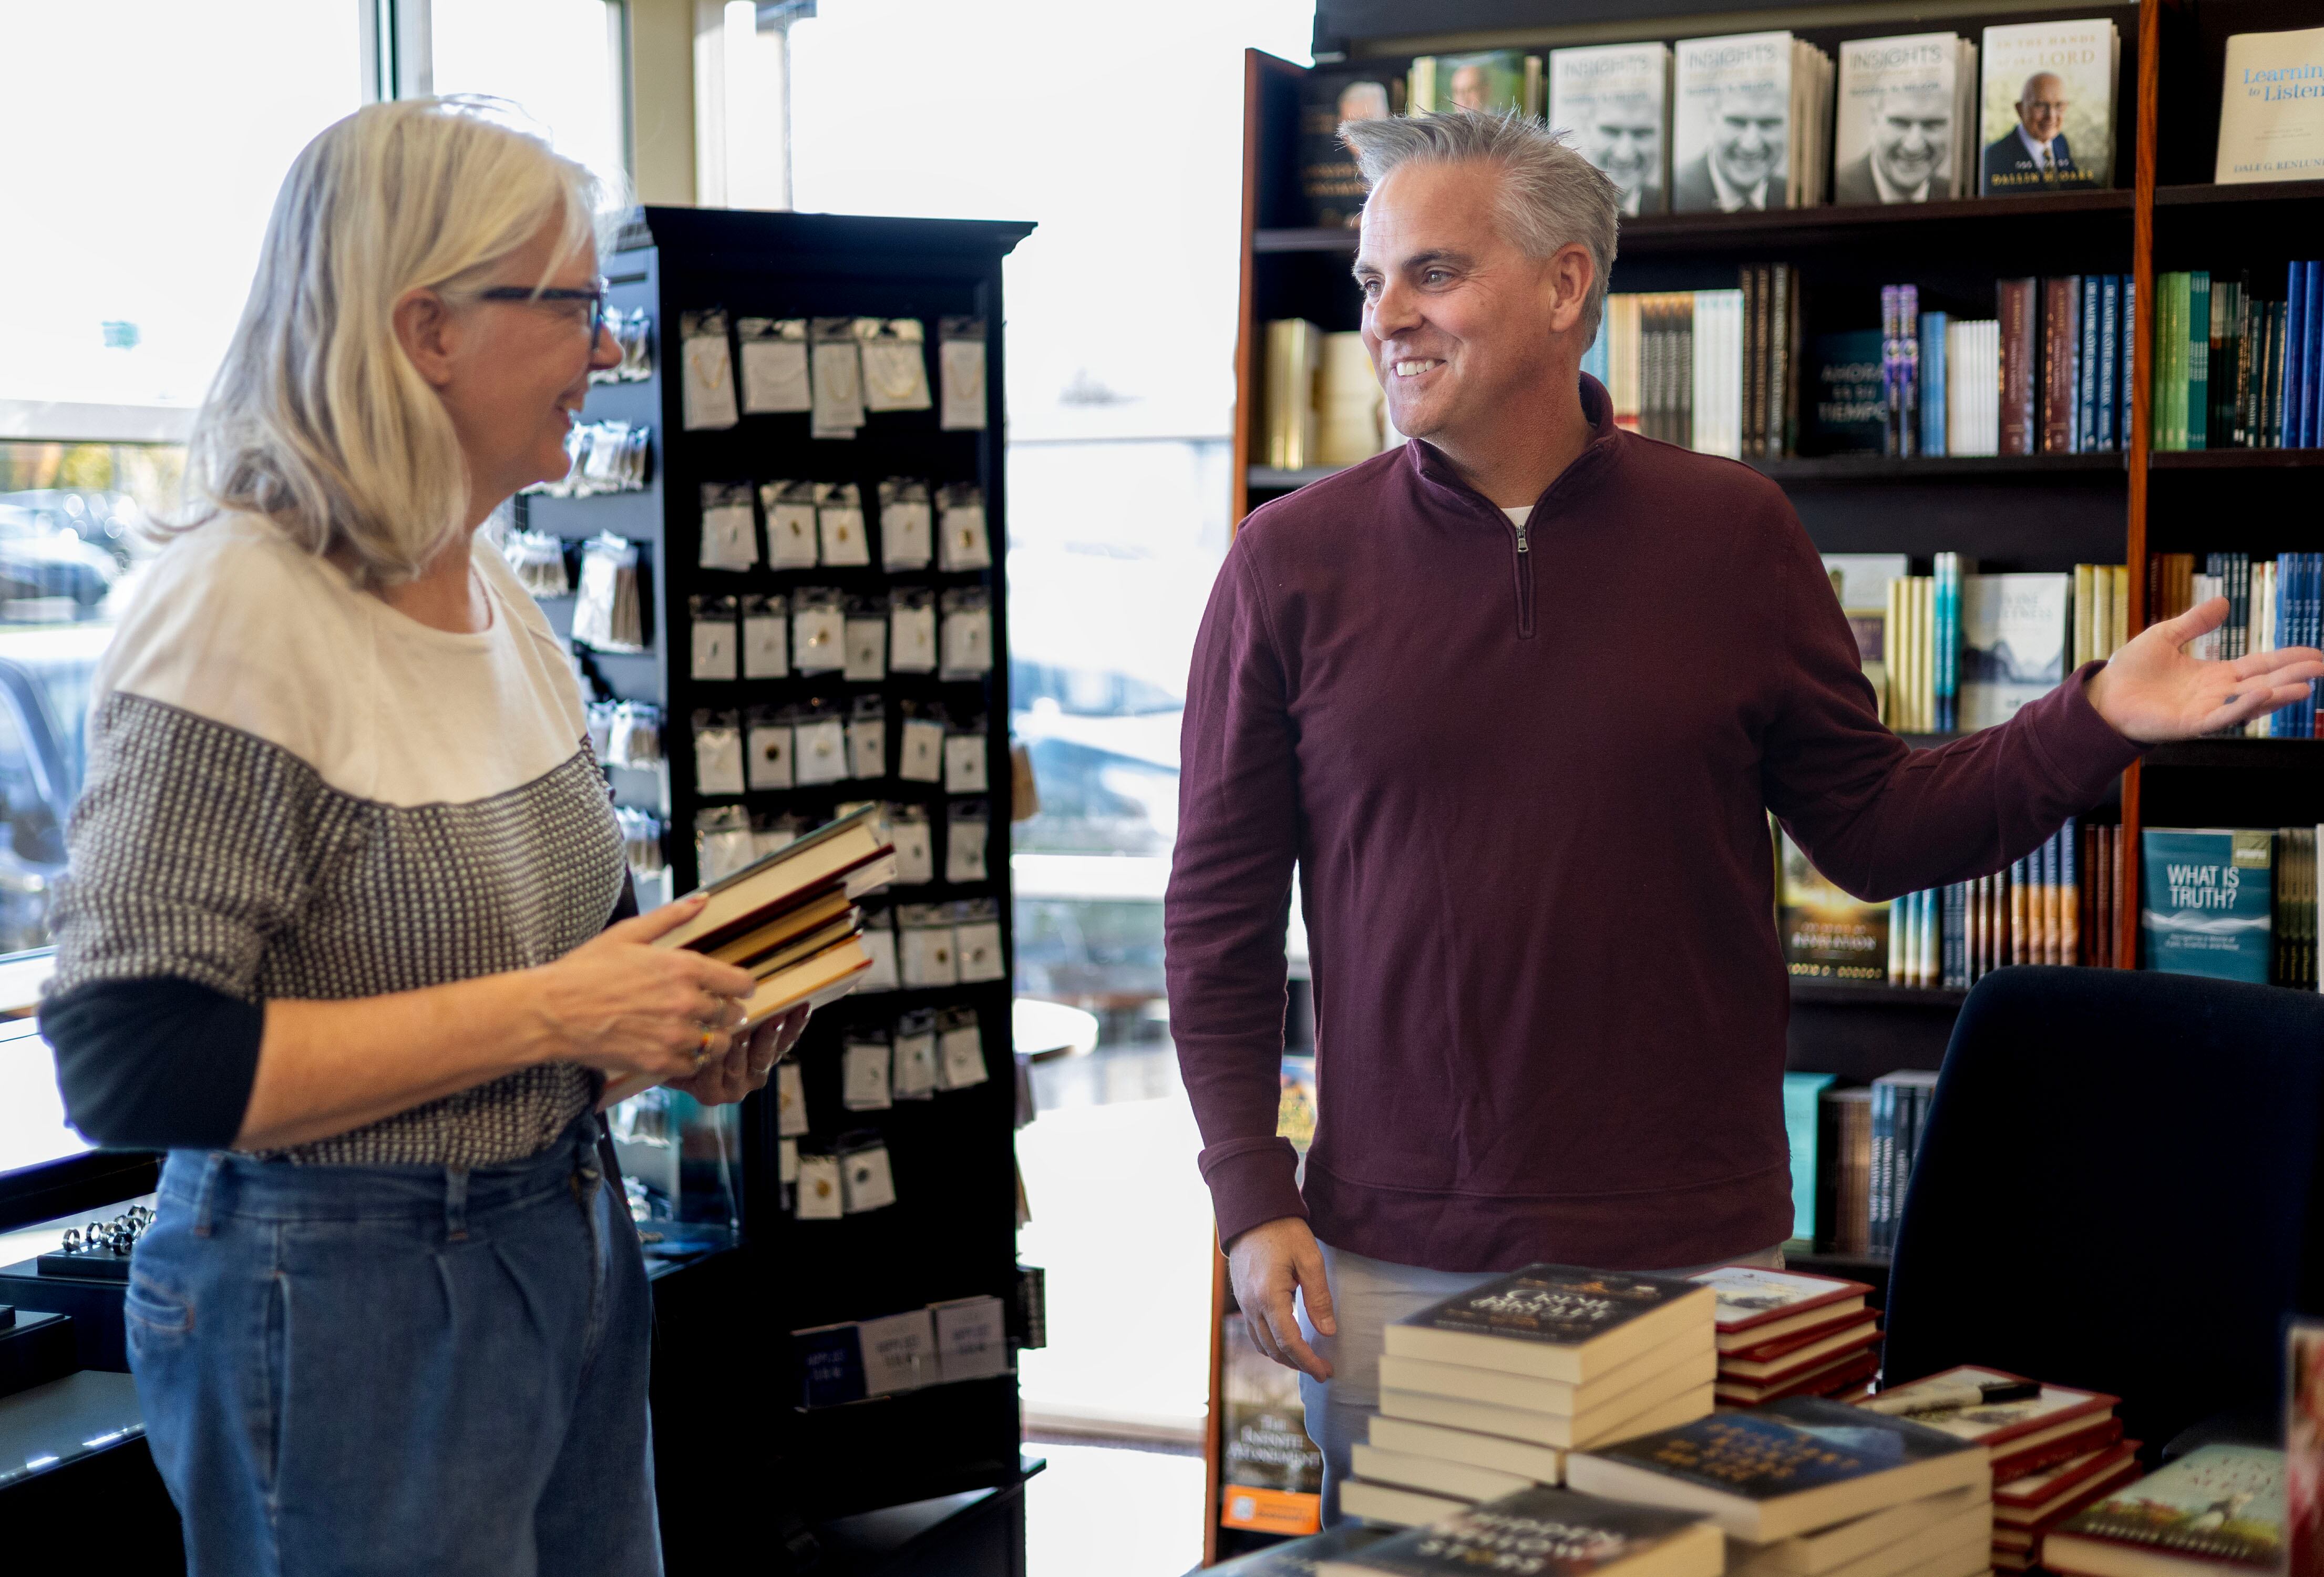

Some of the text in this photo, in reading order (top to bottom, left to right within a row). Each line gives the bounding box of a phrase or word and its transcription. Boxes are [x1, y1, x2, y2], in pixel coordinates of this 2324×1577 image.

[2018, 37, 2042, 48] THE
[2049, 34, 2096, 45] HANDS
[1560, 54, 1651, 78] INSIGHTS
[1686, 44, 1778, 69] INSIGHTS
[1849, 44, 1942, 69] INSIGHTS
[2039, 49, 2095, 66] LORD
[2244, 64, 2324, 84] Learnin
[2248, 84, 2324, 101] to Listen
[2234, 163, 2262, 173] DALE
[2167, 864, 2240, 888] WHAT IS
[2169, 885, 2237, 909] TRUTH?
